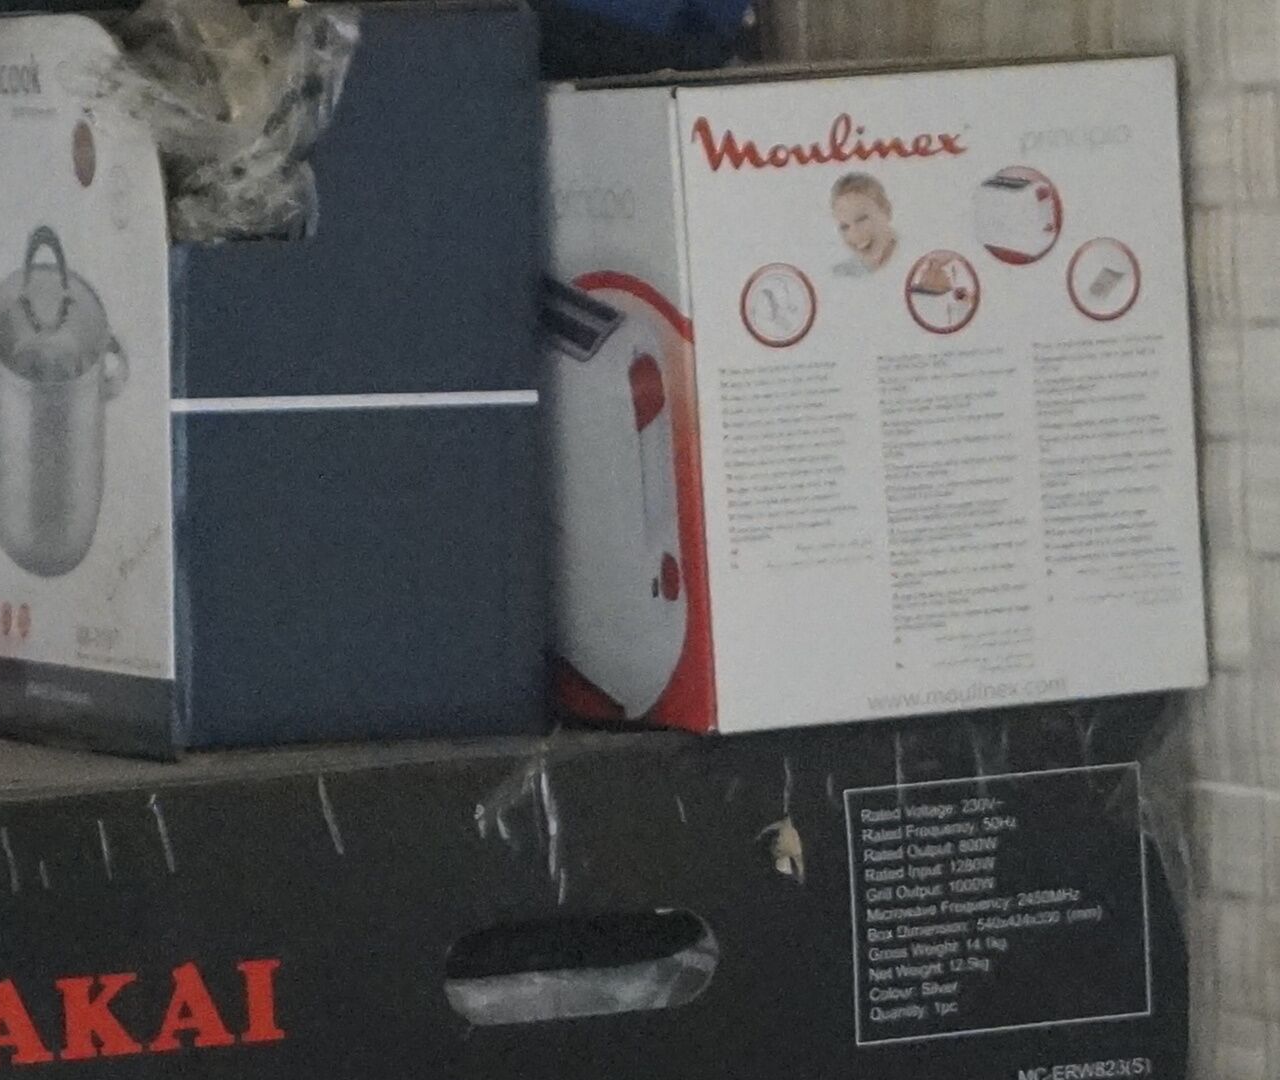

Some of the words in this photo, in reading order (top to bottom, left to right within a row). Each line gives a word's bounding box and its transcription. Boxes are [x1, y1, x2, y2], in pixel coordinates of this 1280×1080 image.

[691, 112, 967, 172] Moulinex
[866, 677, 1067, 710] www.moulinex.com
[861, 808, 901, 822] Rated
[862, 826, 902, 842] Rated
[983, 815, 1018, 831] 50Hz
[863, 844, 904, 861] Rated
[865, 865, 905, 881] Rated
[866, 887, 893, 902] Grill
[949, 877, 995, 892] 1000W
[866, 904, 937, 922] Microwave
[867, 928, 893, 941] Box
[869, 967, 893, 981] Net
[921, 981, 958, 996] Silver
